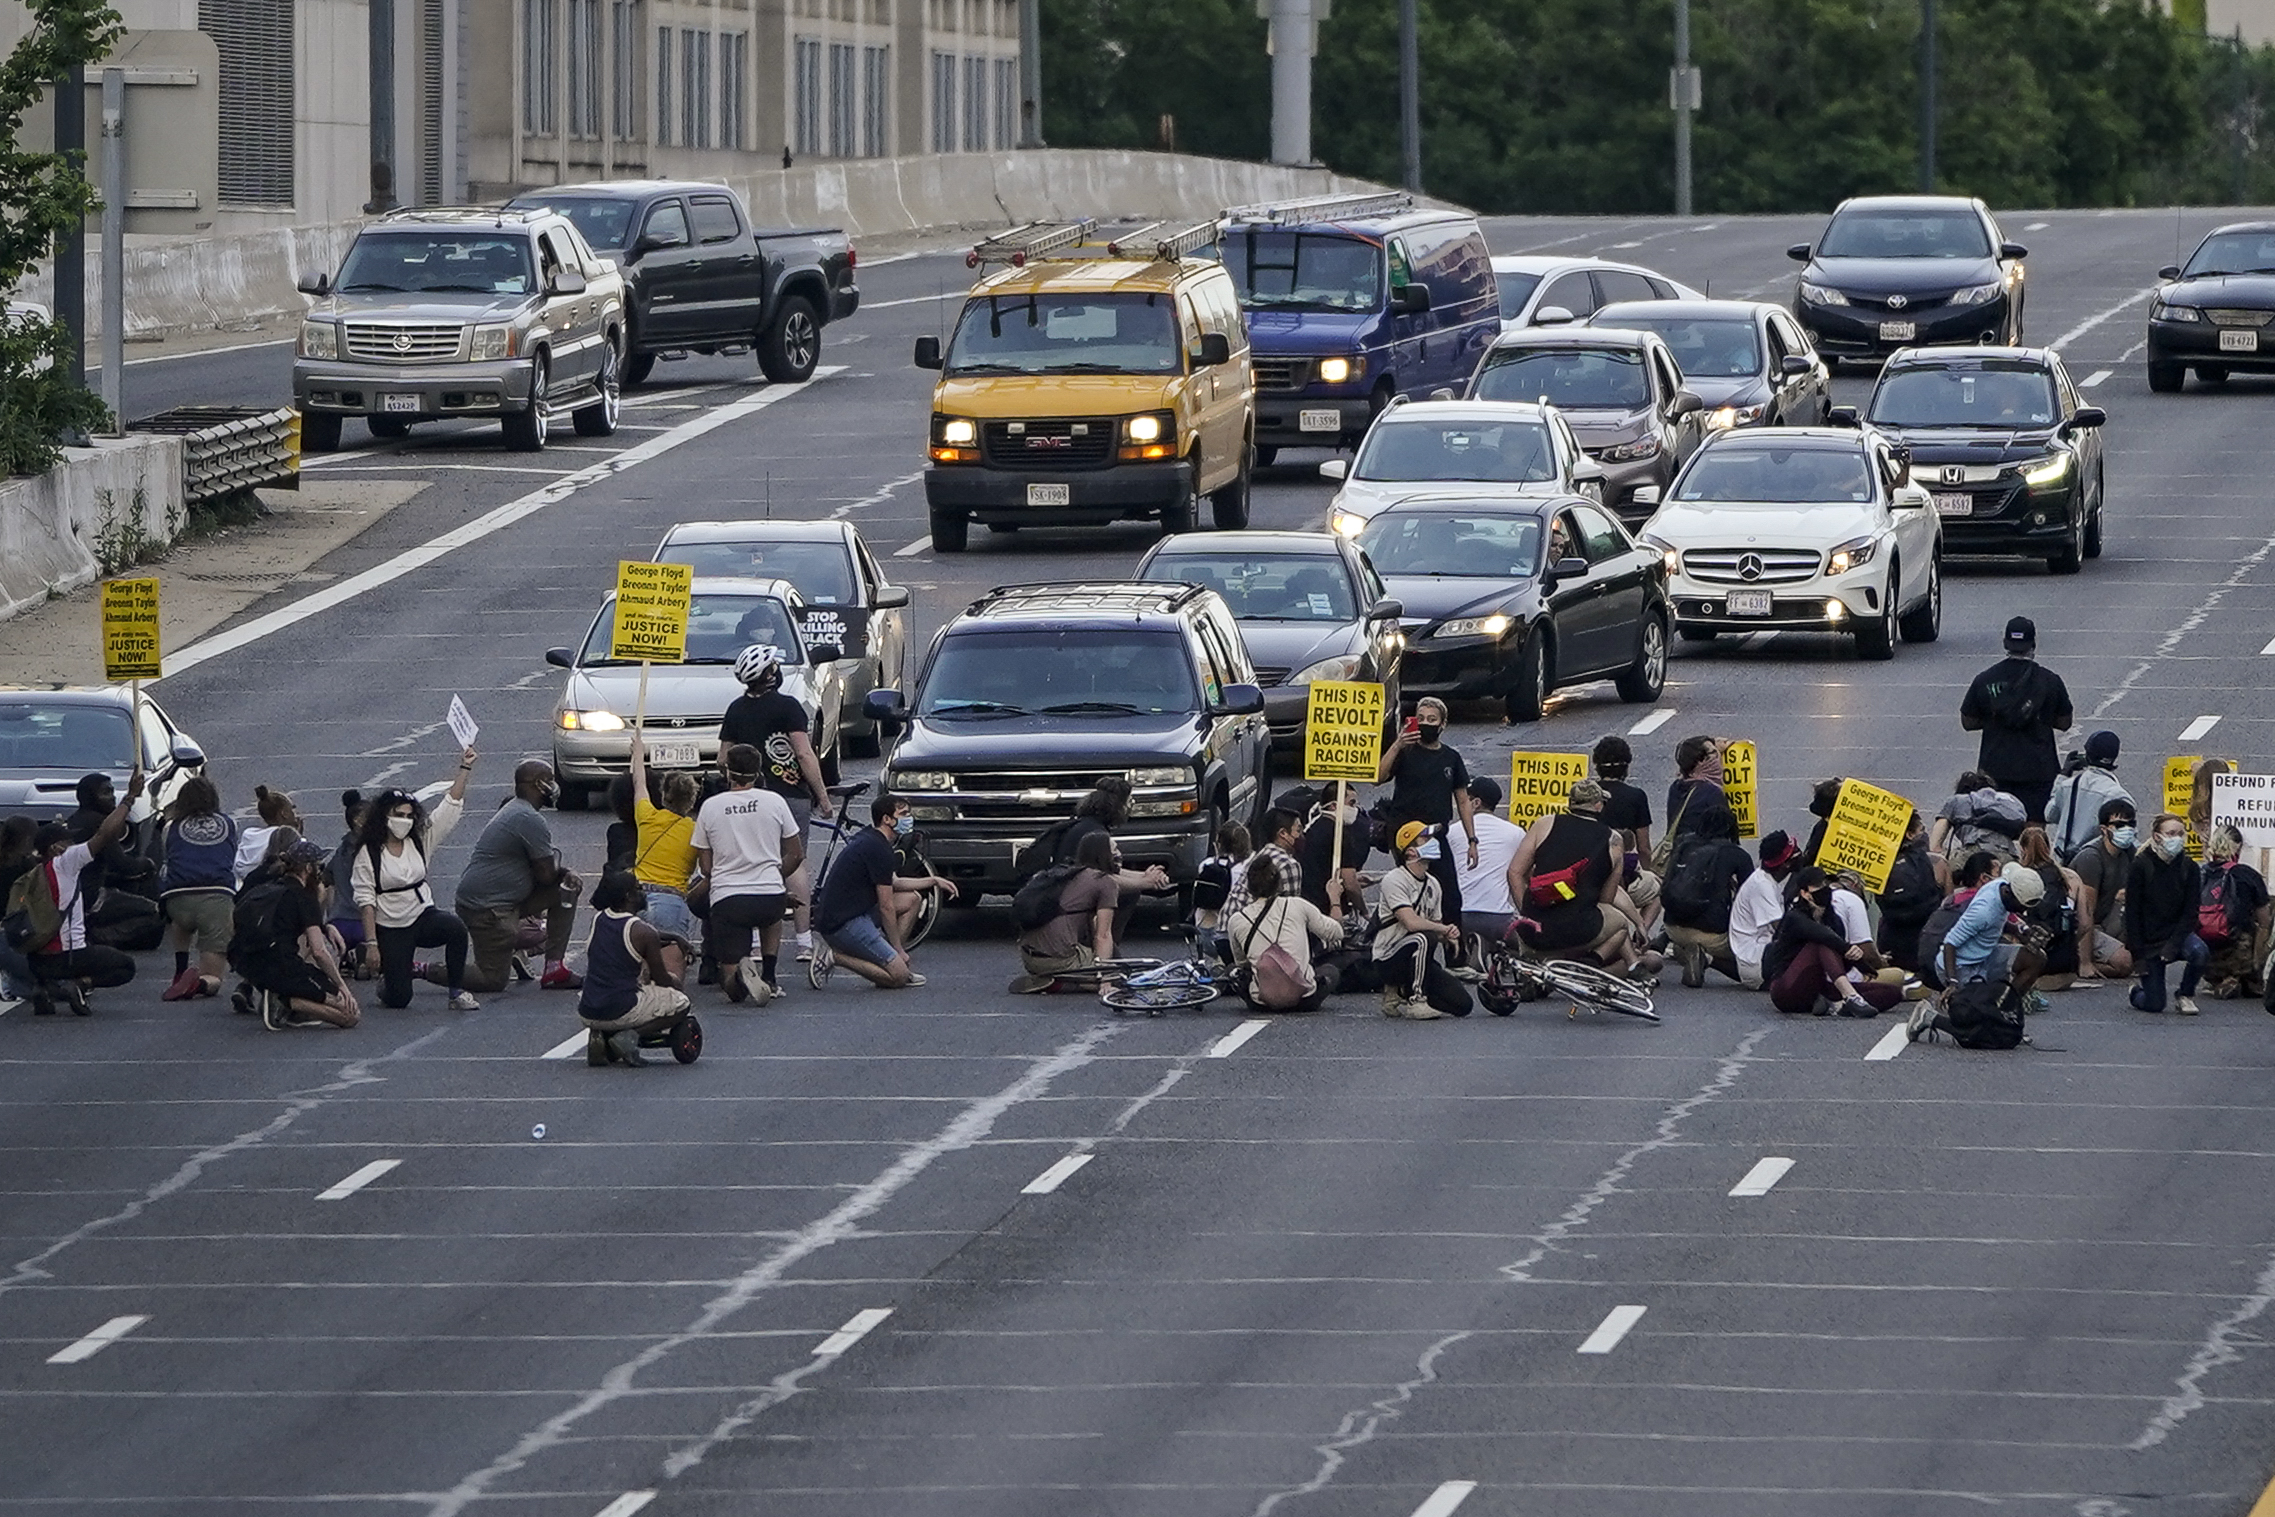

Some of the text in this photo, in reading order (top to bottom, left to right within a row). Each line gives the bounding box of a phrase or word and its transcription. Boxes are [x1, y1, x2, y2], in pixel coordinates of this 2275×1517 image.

[1026, 436, 1071, 447] GMC
[627, 564, 684, 580] George Floyd
[109, 582, 153, 596] George Floyd
[622, 579, 688, 595] Breonna Taylor
[105, 597, 157, 610] Breonna Taylor
[620, 593, 687, 609] Ahmaud Arbery
[105, 612, 157, 624] Ahmaud Arbery
[806, 611, 838, 622] STOP
[621, 621, 679, 634] JUSTICE
[798, 622, 847, 634] KILLING
[108, 639, 155, 651] JUSTICE
[631, 633, 667, 645] NOW!
[803, 633, 842, 644] BLACK
[117, 652, 147, 663] NOW!
[1314, 688, 1380, 705] THIS IS A
[1313, 706, 1379, 726] REVOLT
[1311, 731, 1378, 748] AGAINST
[1315, 748, 1371, 764] RACISM
[1723, 749, 1751, 764] IS A
[1517, 759, 1583, 777] THIS IS A
[1723, 766, 1751, 785] OLT
[1516, 777, 1577, 797] REVOL
[2215, 775, 2266, 788] DEFUND
[1850, 784, 1905, 811] George Floyd
[724, 799, 758, 815] staff
[1514, 803, 1571, 817] AGAINS
[1840, 796, 1904, 827] Breonna Taylor
[1835, 810, 1899, 842] Ahmaud Arbery
[1830, 838, 1887, 865] JUSTICE
[1836, 852, 1873, 872] NOW!
